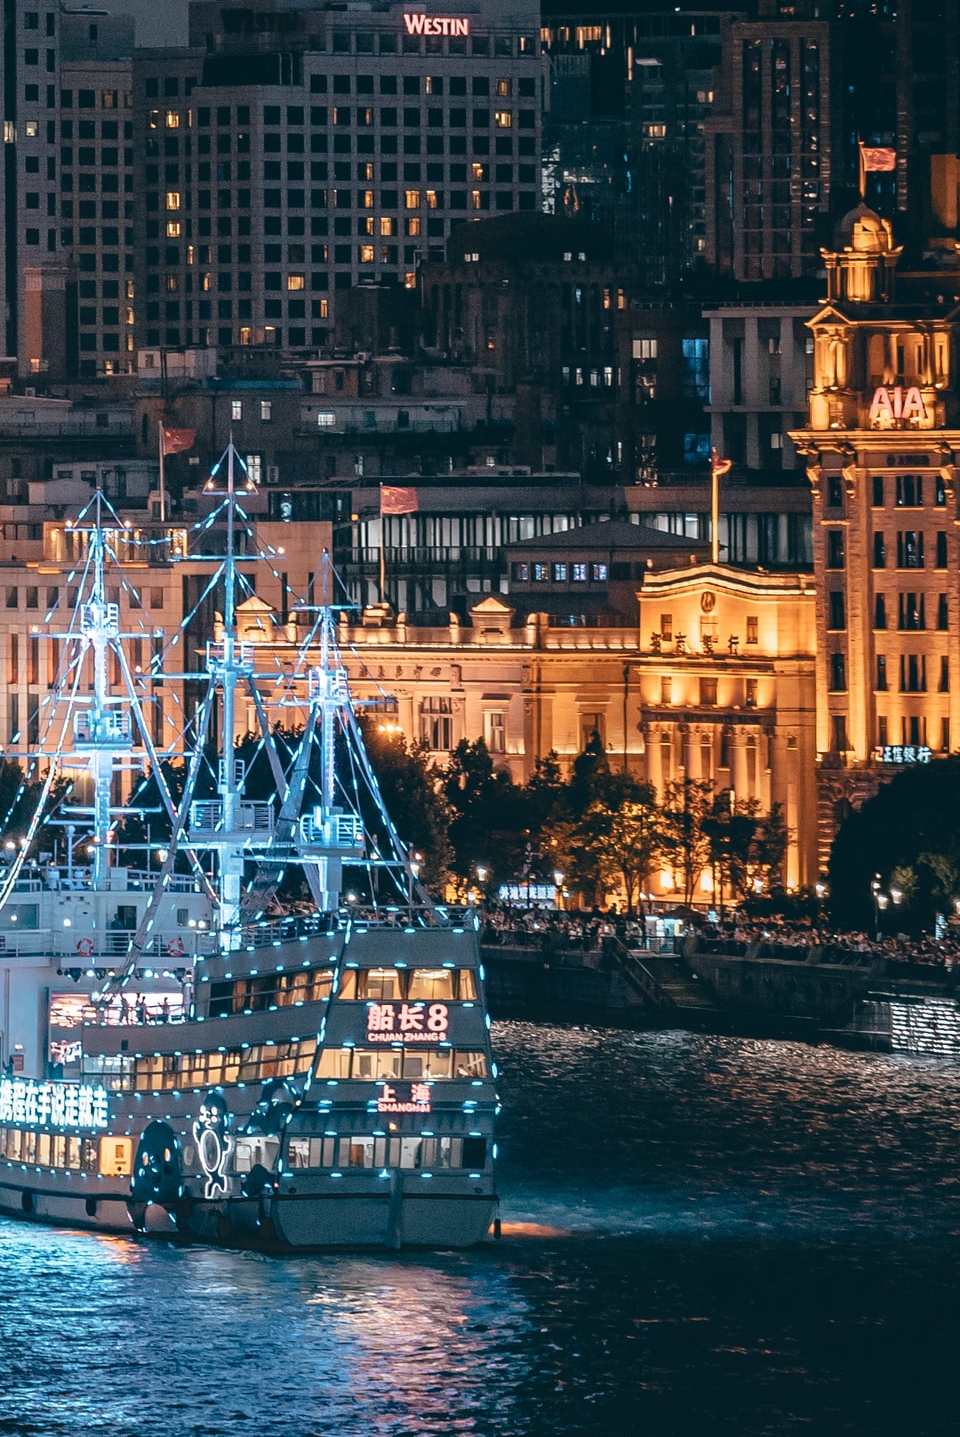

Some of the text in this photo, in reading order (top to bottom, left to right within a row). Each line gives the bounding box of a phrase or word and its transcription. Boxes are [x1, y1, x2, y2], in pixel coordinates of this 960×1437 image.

[403, 14, 470, 36] WESTIN
[869, 386, 927, 419] AIA
[367, 1003, 448, 1031] 船长8
[368, 1033, 403, 1042] CHUAN
[377, 1083, 431, 1103] 上海
[378, 1102, 431, 1112] SHANGHAI
